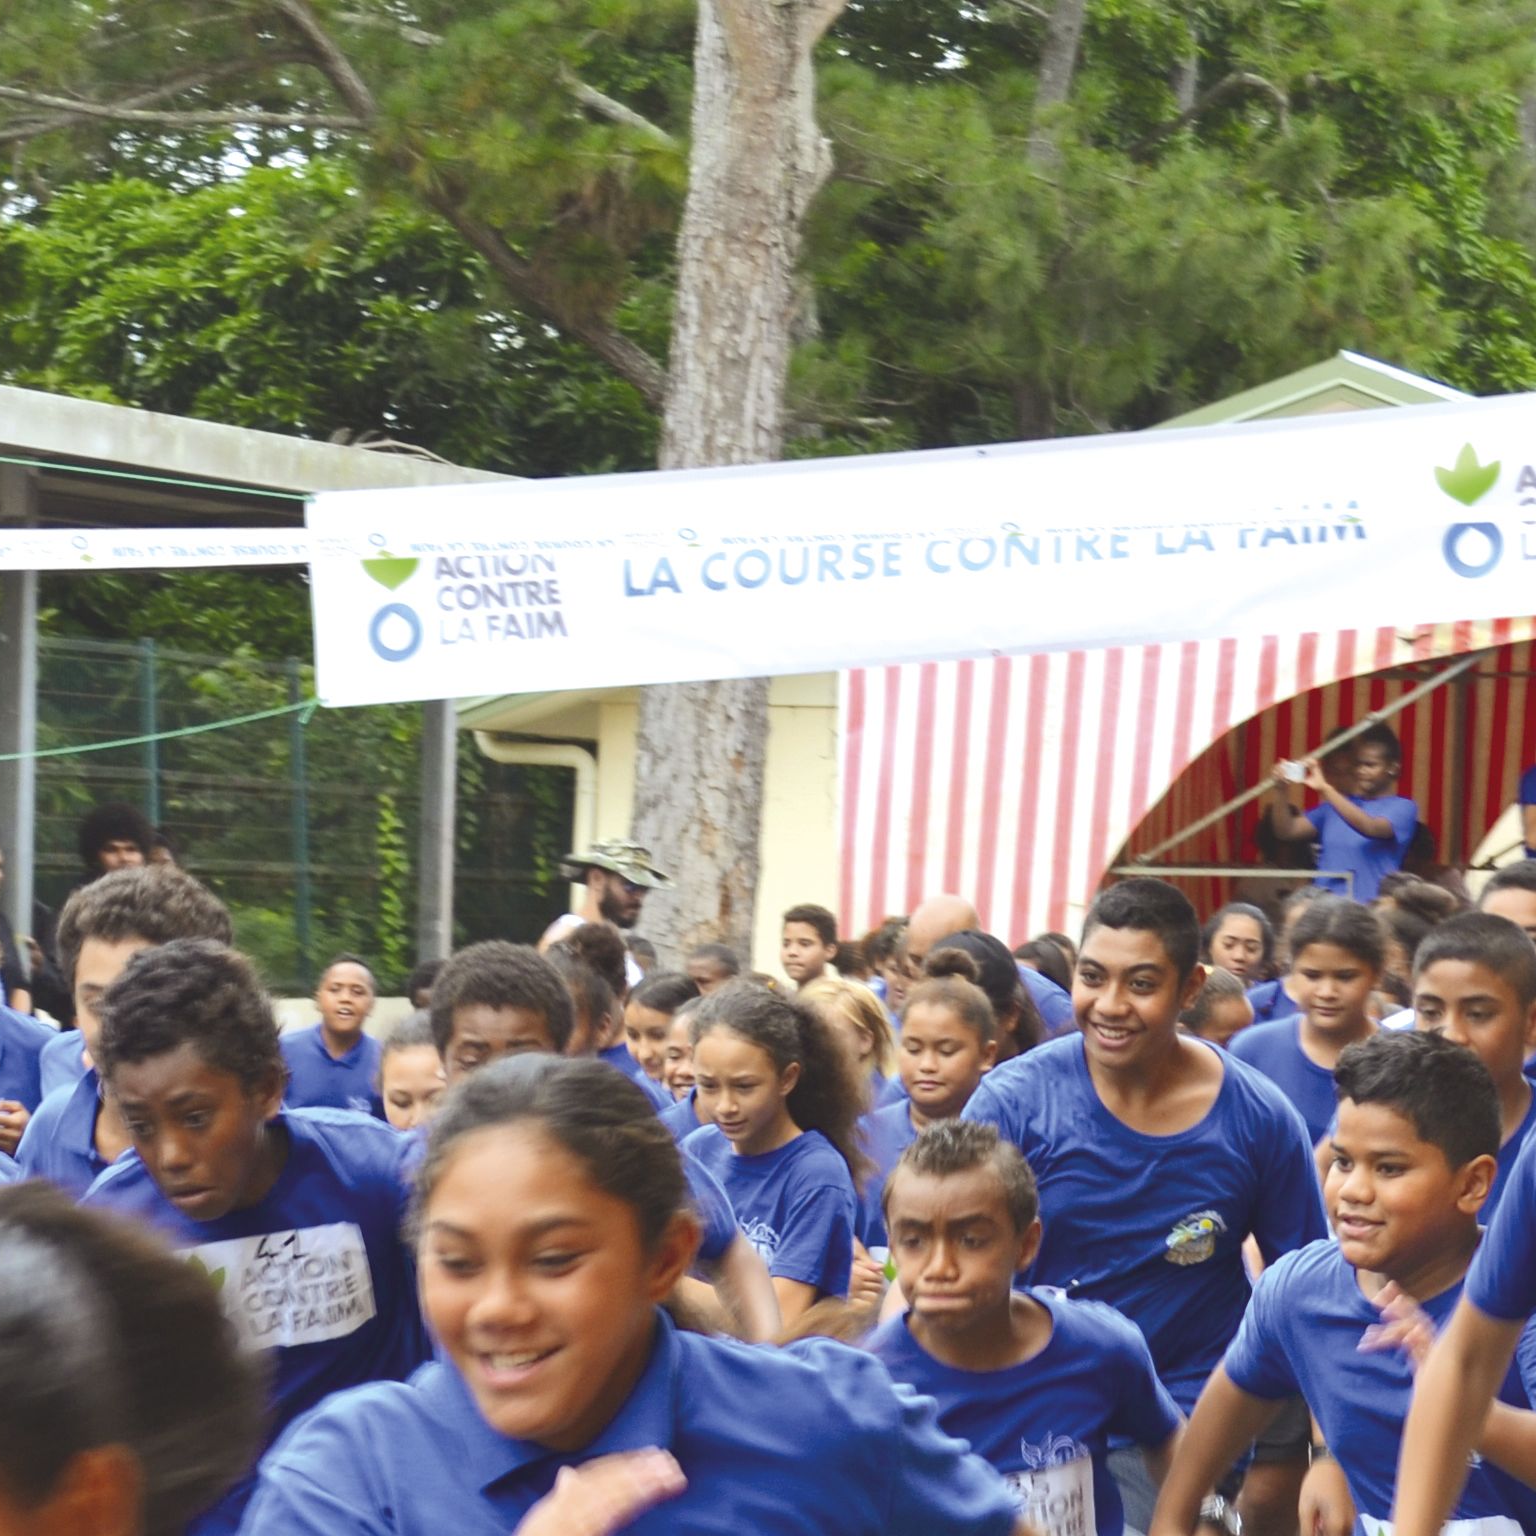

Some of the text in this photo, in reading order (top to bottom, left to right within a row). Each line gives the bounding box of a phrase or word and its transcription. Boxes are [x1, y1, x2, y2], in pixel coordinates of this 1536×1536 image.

[434, 553, 556, 581] ACTION
[623, 556, 683, 597] LA
[700, 542, 902, 592] COURSE
[437, 579, 563, 612] CONTRE
[439, 610, 569, 645] LA FAIM
[240, 1250, 352, 1291] ACTION
[244, 1274, 358, 1313] CONTRE
[249, 1298, 363, 1336] LA FAIM
